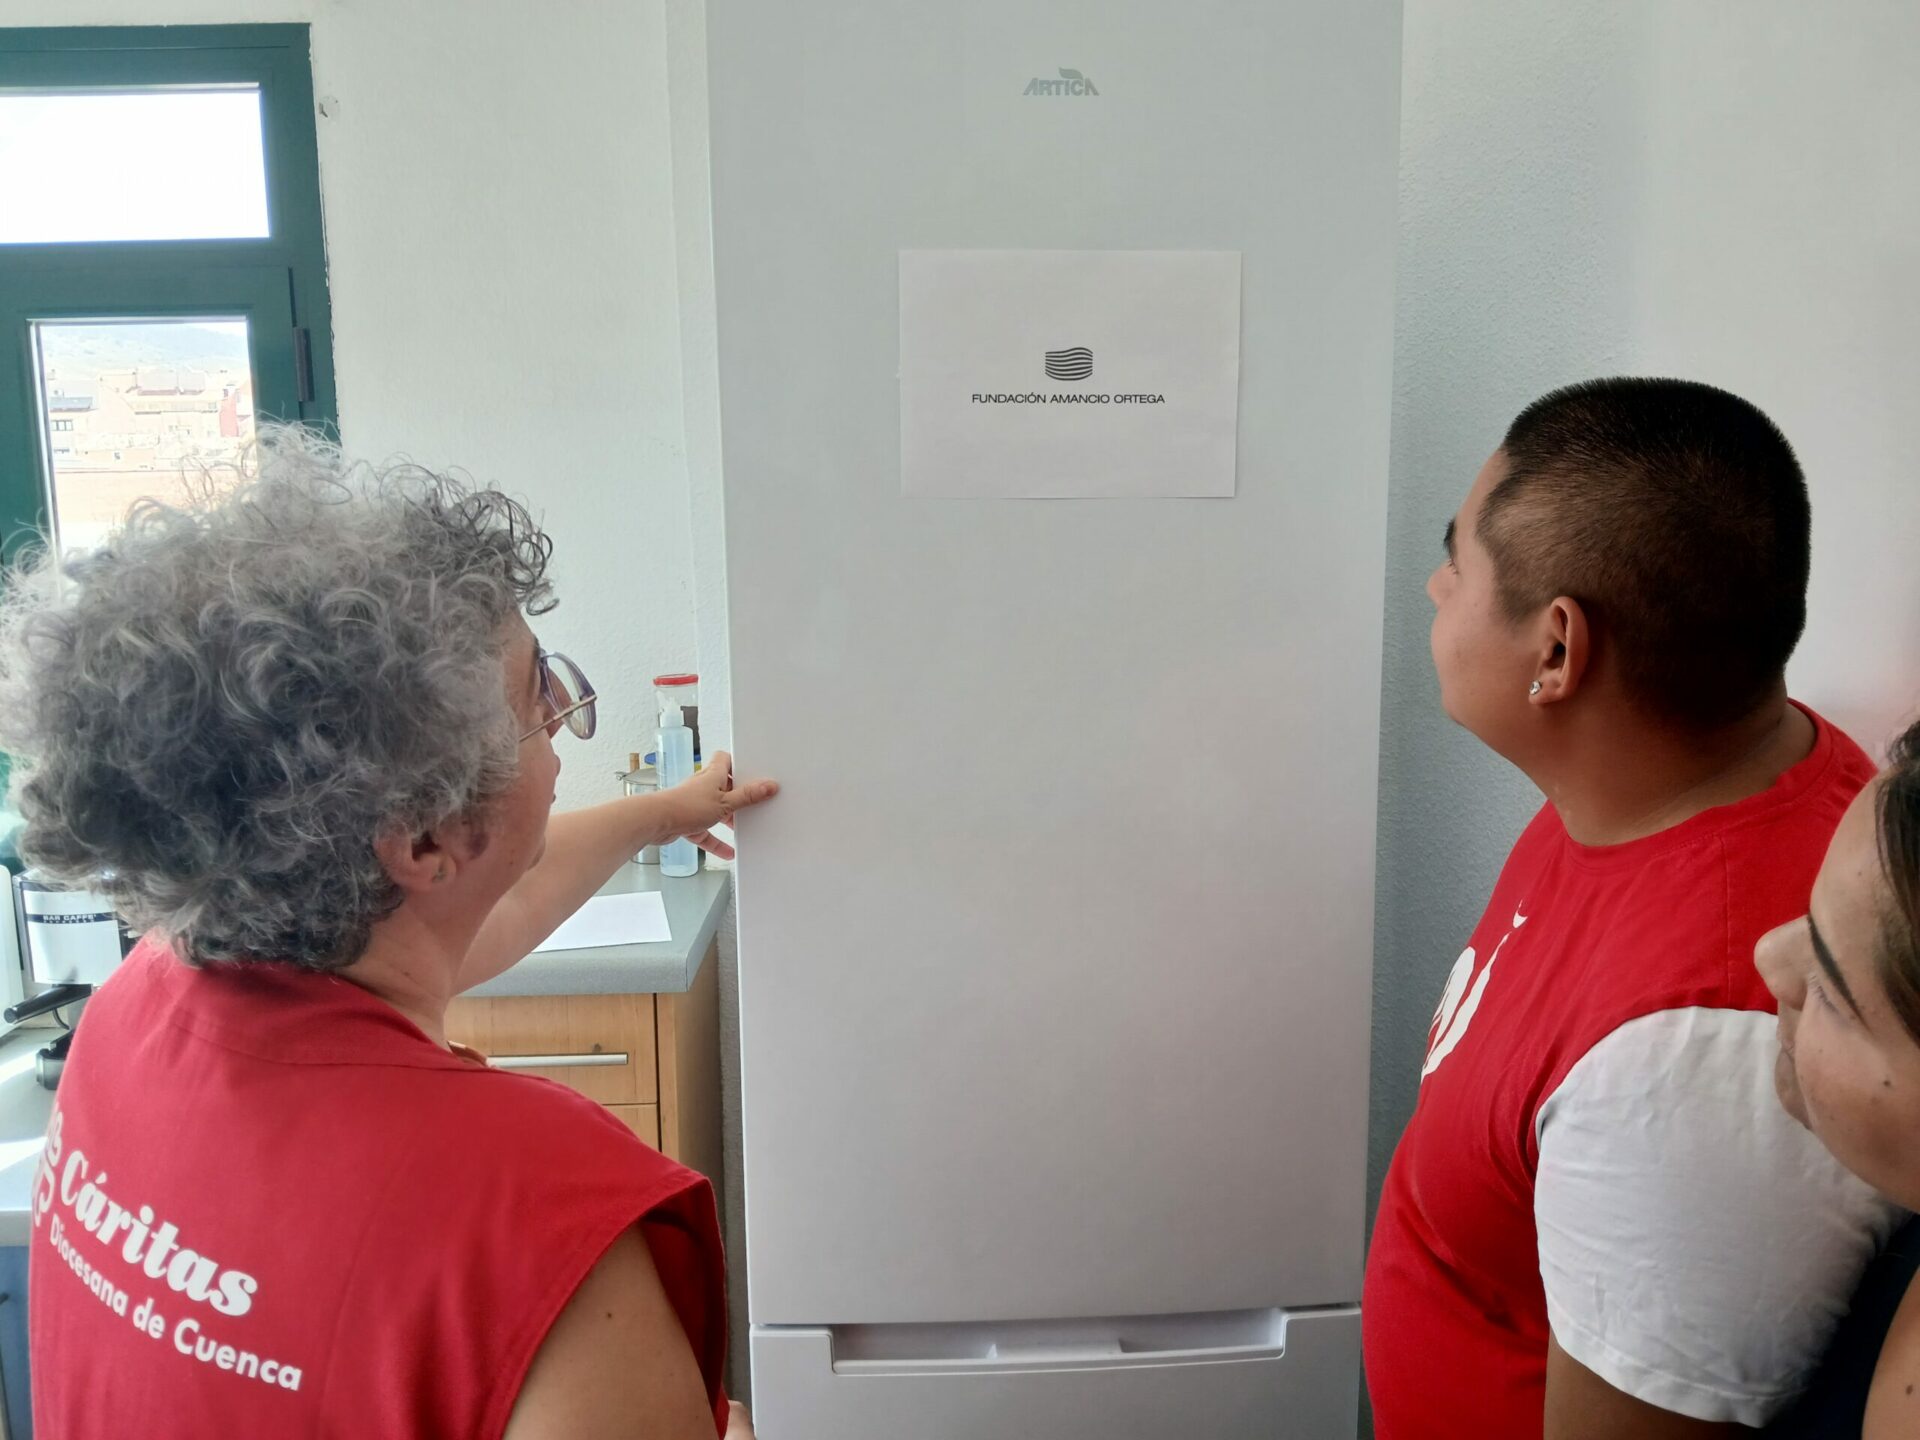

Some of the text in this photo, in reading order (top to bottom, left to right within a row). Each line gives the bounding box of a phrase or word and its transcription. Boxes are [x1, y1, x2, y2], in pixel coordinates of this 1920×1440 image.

[1023, 77, 1100, 96] ARTICA
[972, 392, 1165, 404] FUNDACIÓN AMANCIO ORTEGA
[61, 1150, 258, 1316] Cáritas
[50, 1212, 302, 1391] Diocesana de Cuenca
